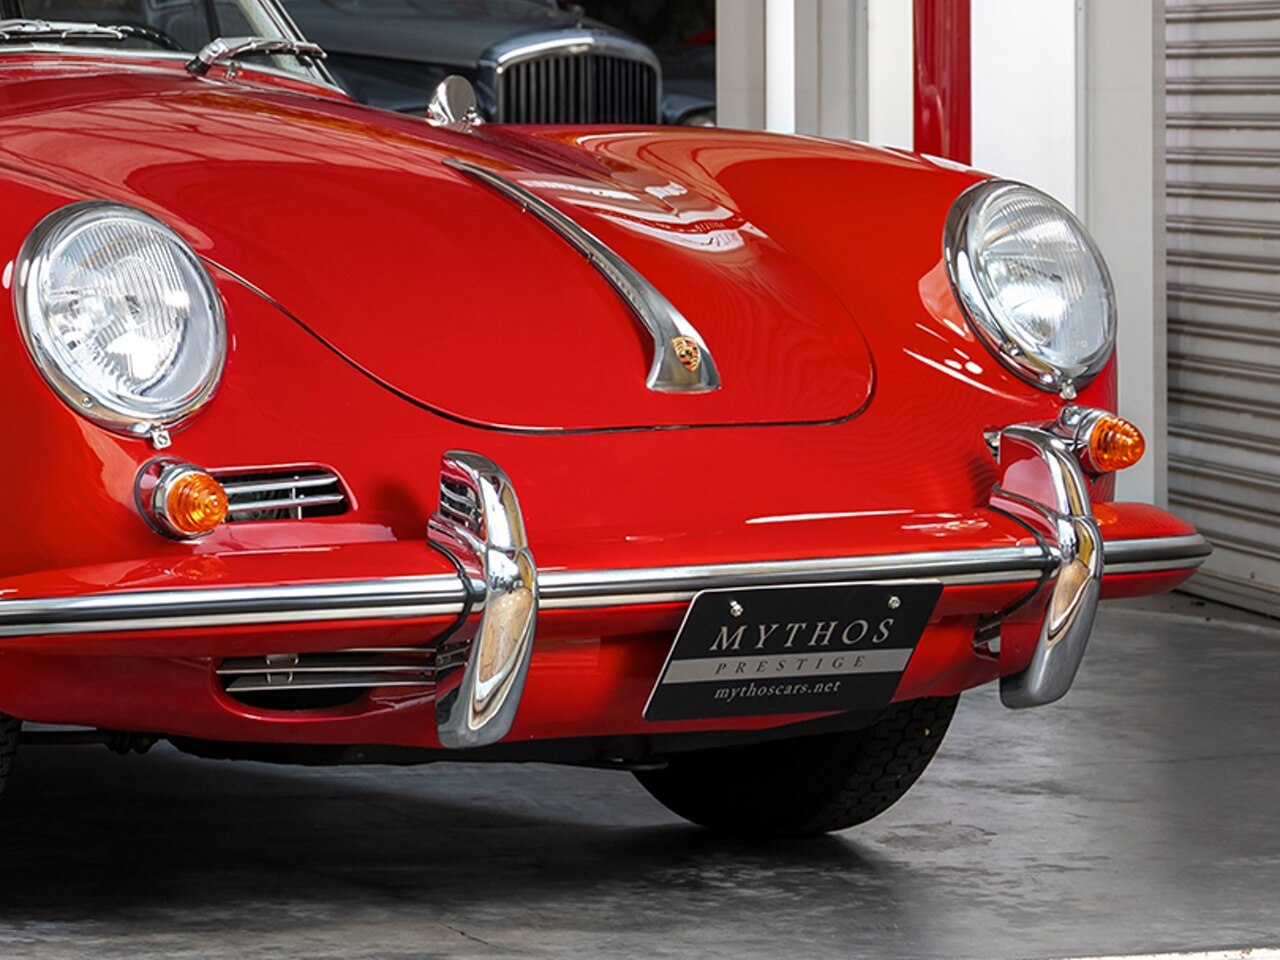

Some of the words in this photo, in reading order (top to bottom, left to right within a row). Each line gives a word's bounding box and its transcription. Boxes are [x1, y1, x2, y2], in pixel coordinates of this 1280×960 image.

[710, 618, 894, 651] MYTHOS
[716, 655, 866, 674] PRESTIGE
[715, 681, 841, 702] mythoscars.net
